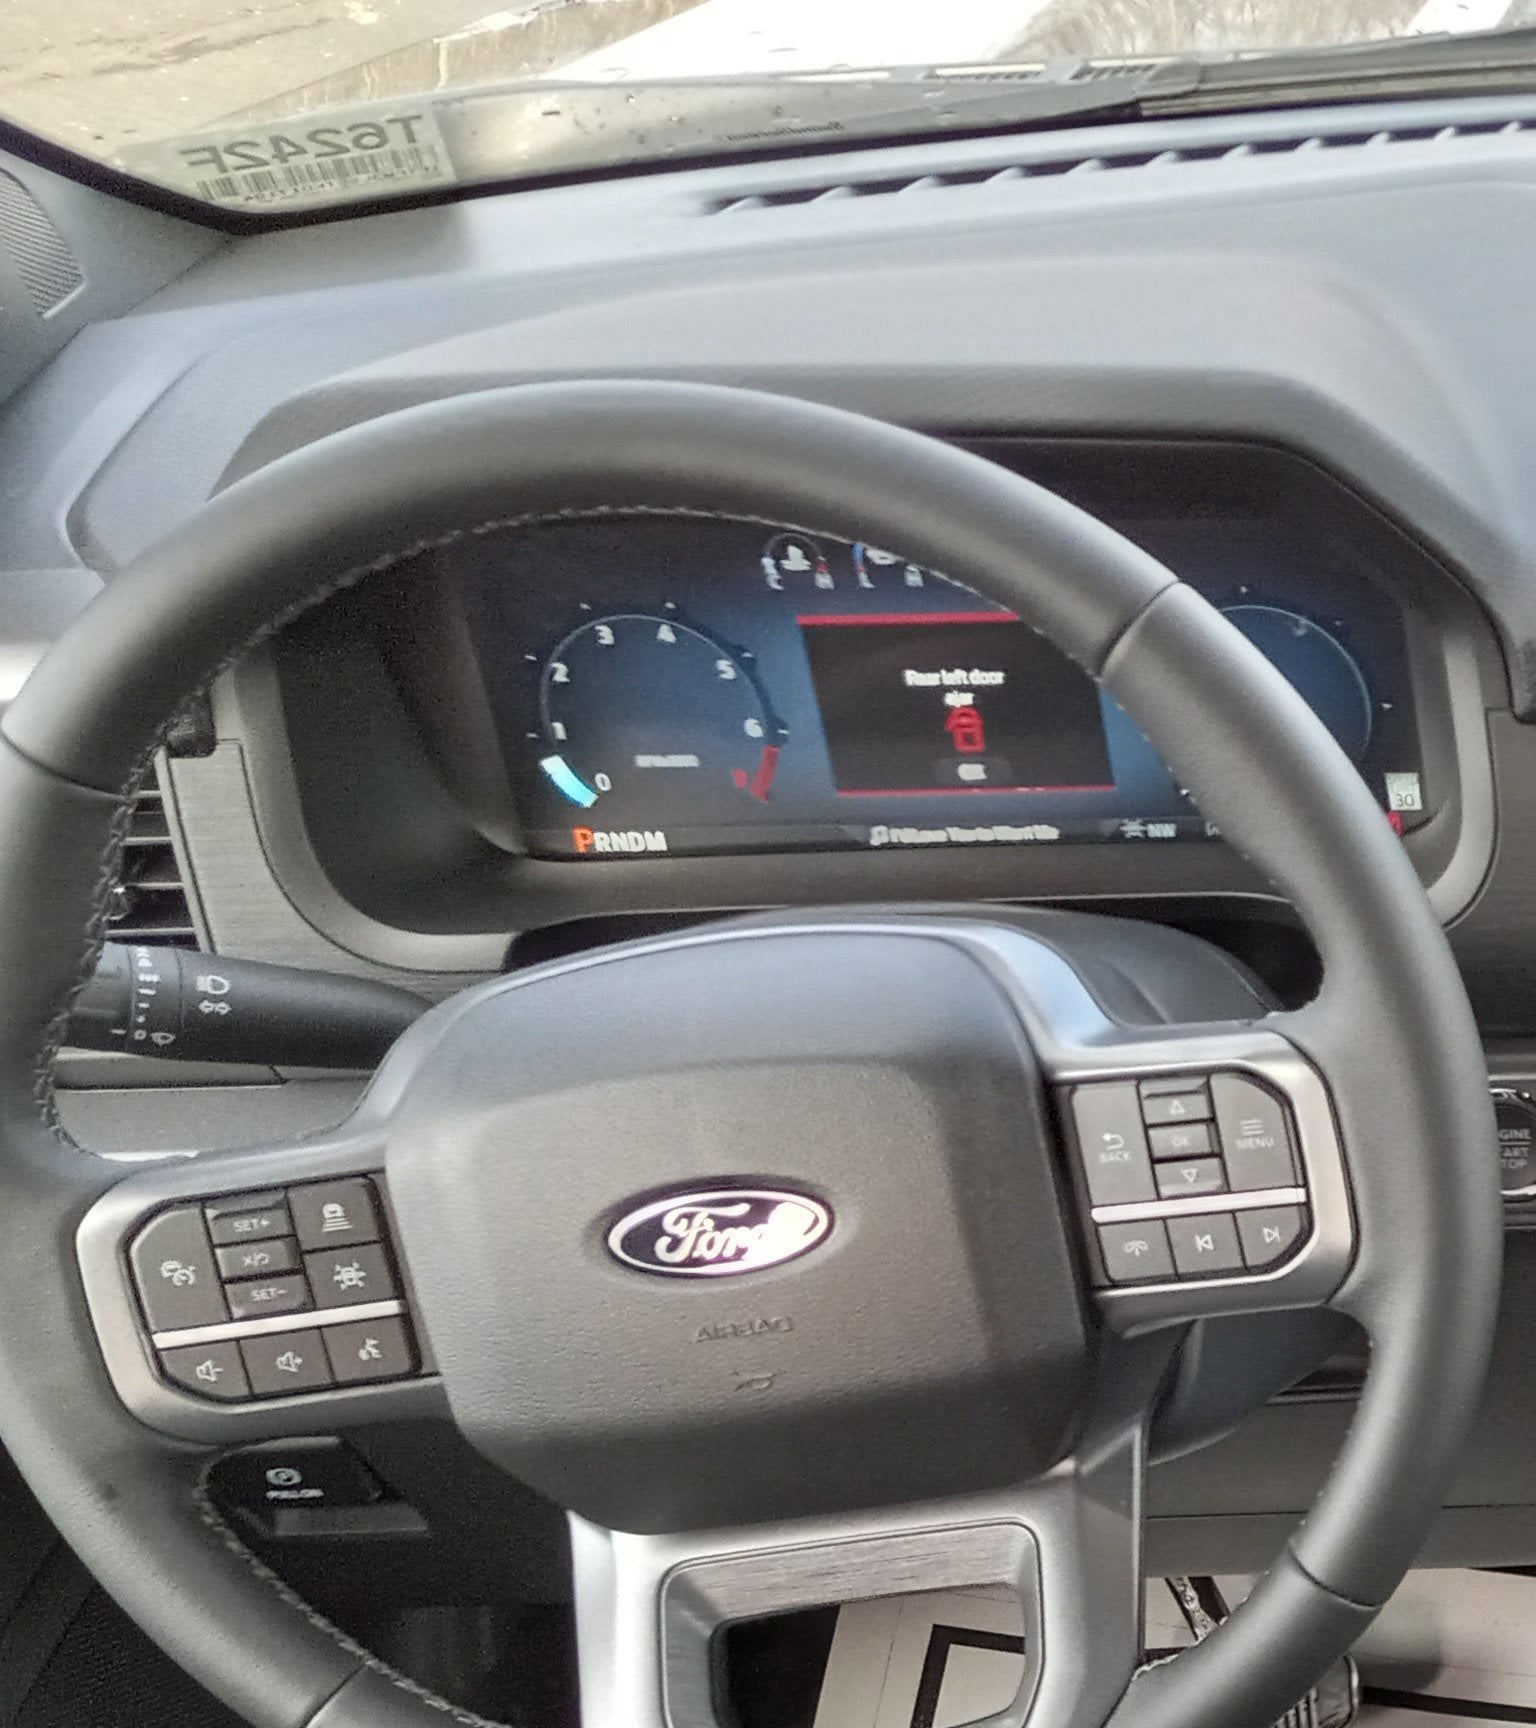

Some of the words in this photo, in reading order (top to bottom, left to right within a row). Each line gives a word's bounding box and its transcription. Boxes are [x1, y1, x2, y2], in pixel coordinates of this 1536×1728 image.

[595, 625, 614, 645] 3
[657, 624, 676, 643] 4
[551, 662, 570, 682] 2
[716, 659, 737, 680] 5
[552, 722, 567, 740] 1
[744, 718, 764, 738] 6
[595, 773, 611, 791] 0
[1236, 1136, 1275, 1150] MENU
[1499, 1128, 1532, 1140] GINE
[1099, 1149, 1132, 1164] BACK
[655, 1201, 810, 1264] For
